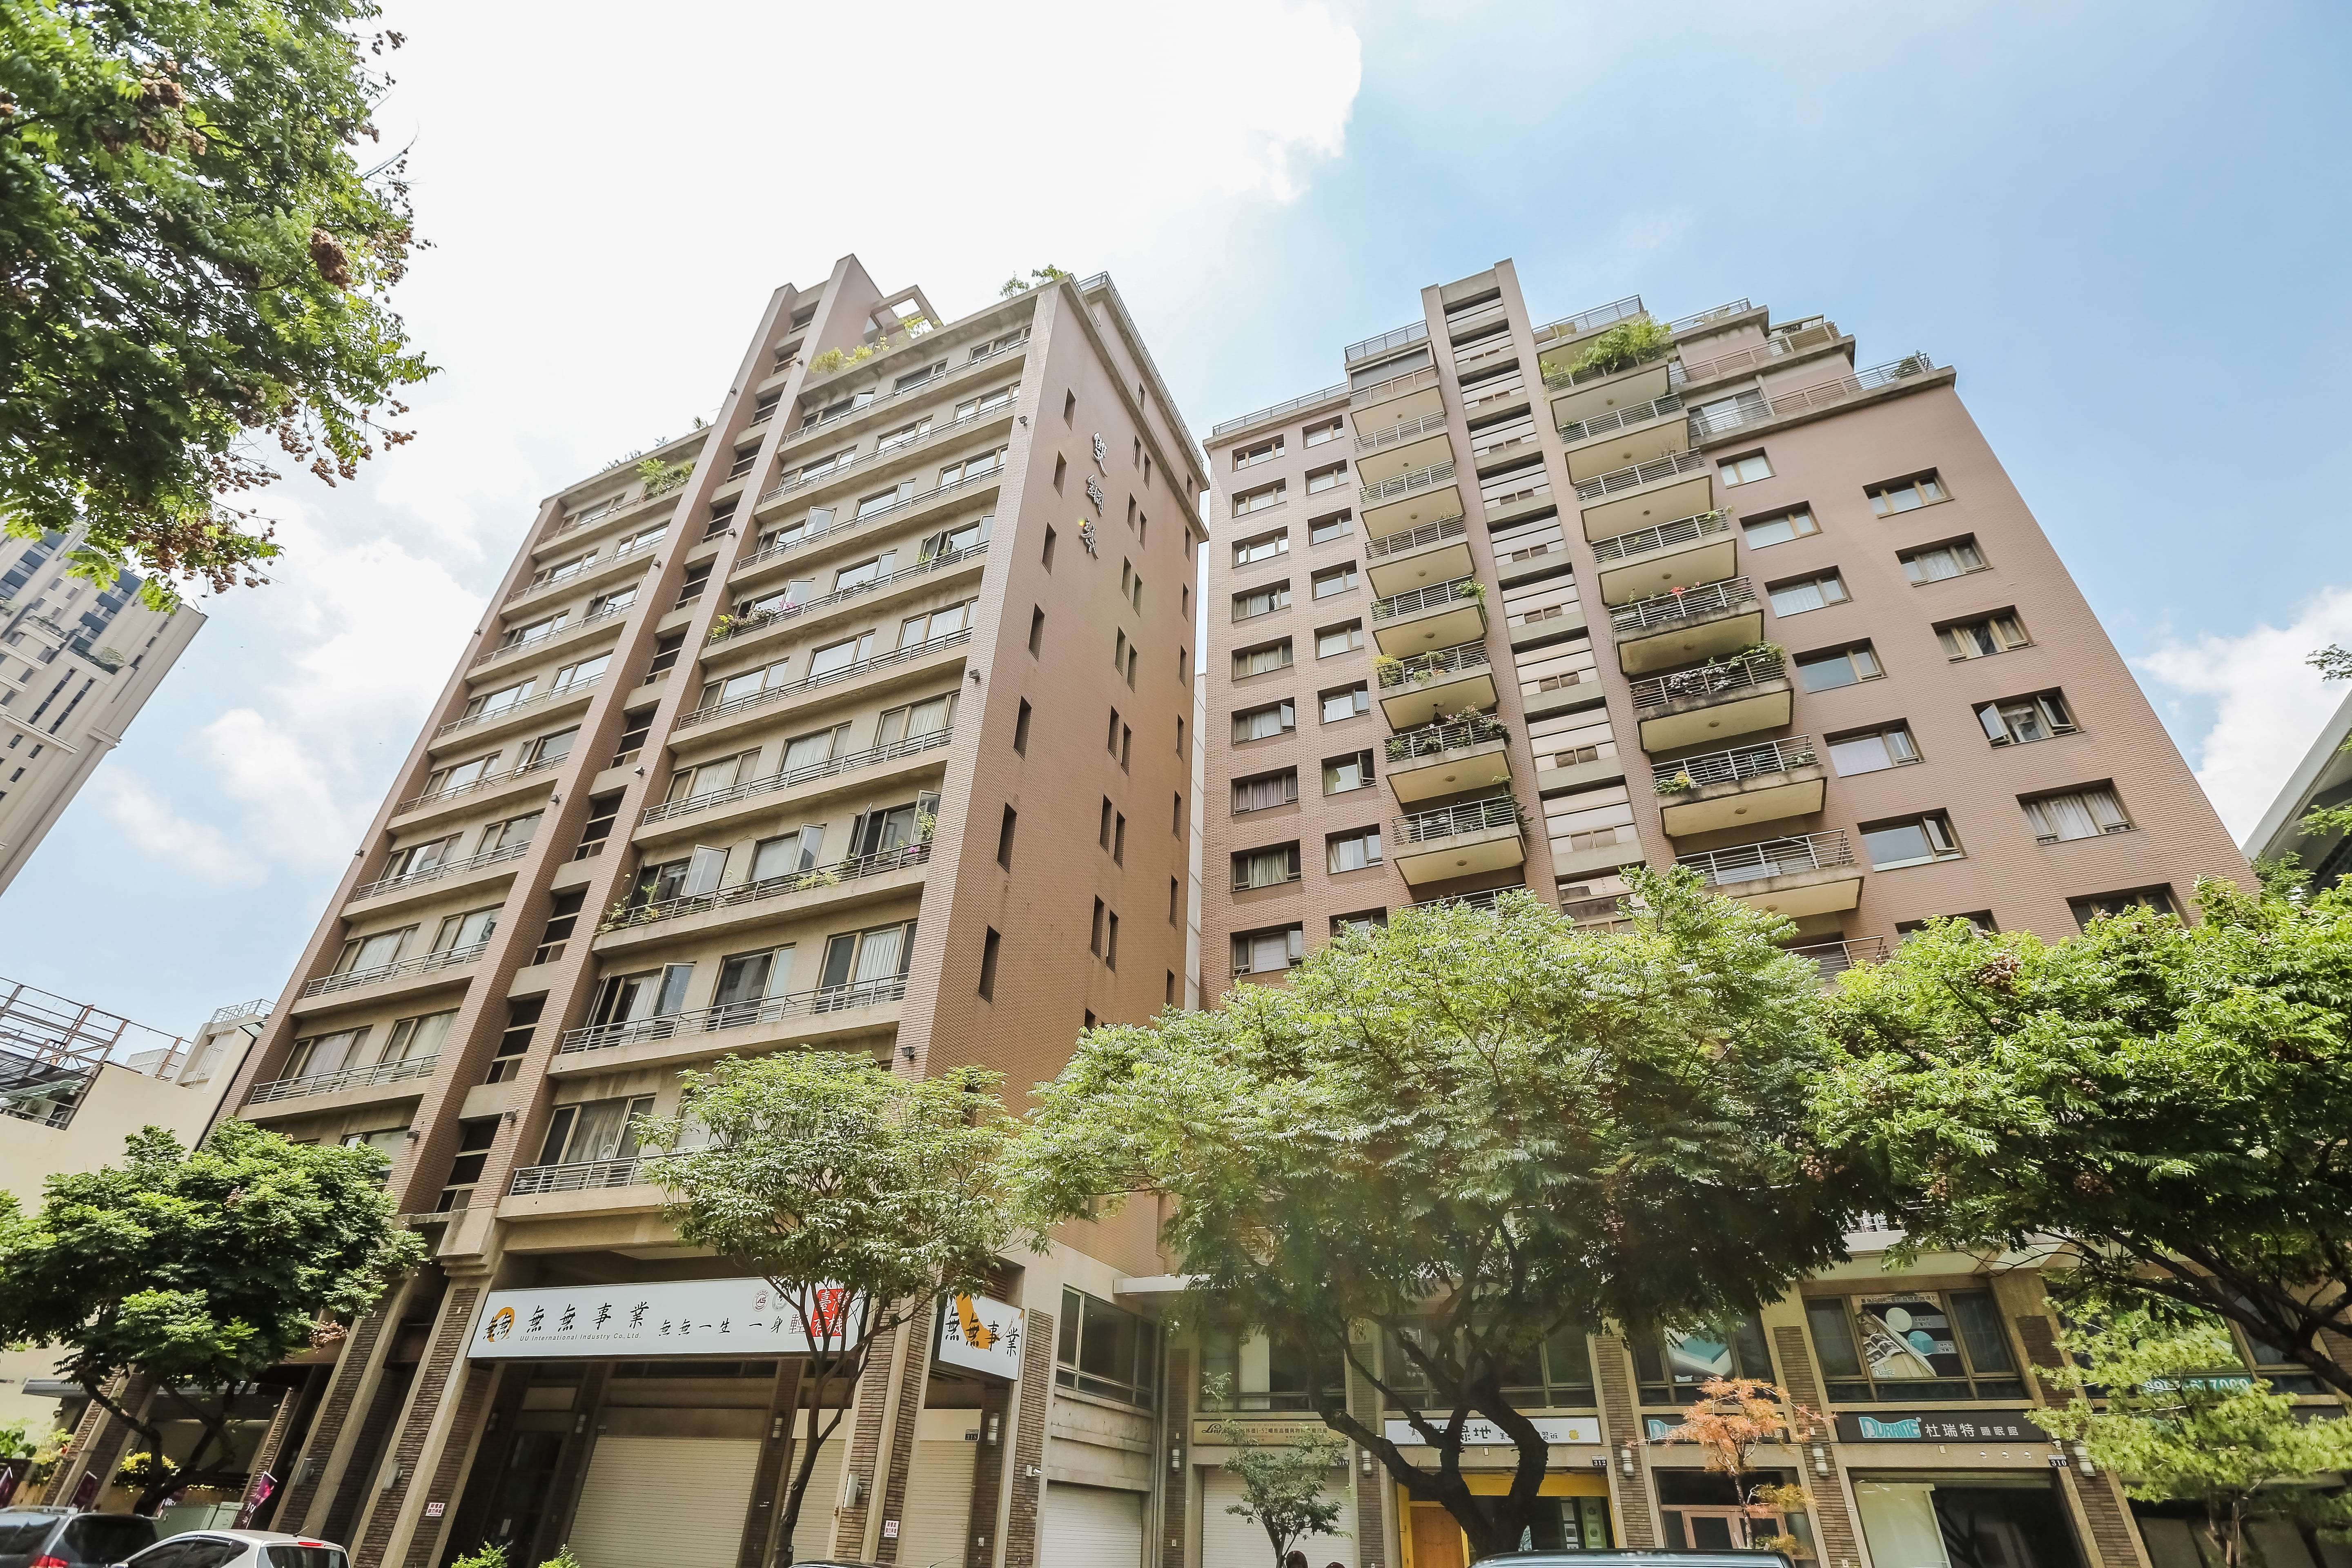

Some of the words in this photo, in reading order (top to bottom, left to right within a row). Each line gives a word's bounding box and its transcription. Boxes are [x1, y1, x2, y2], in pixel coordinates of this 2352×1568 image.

[526, 1301, 649, 1333] 無無事業
[945, 1306, 1020, 1357] 無無事業
[1925, 1423, 1975, 1437] 杜瑞特
[1980, 1426, 2018, 1436] 睡眠館
